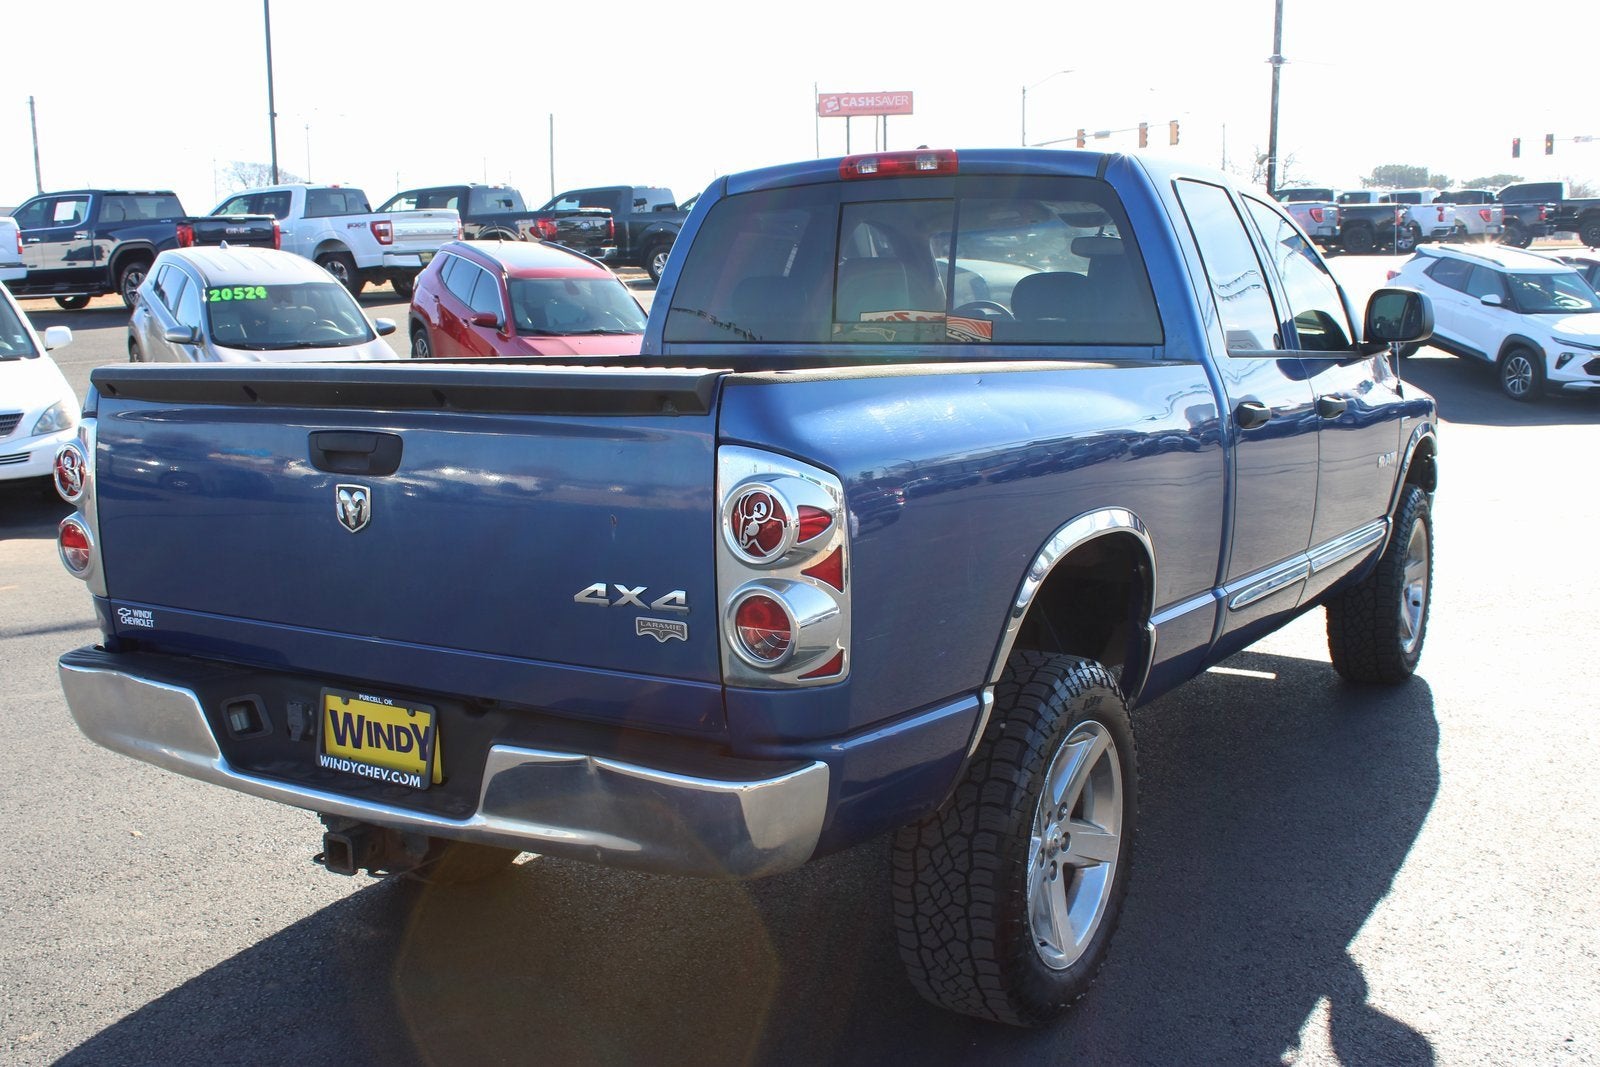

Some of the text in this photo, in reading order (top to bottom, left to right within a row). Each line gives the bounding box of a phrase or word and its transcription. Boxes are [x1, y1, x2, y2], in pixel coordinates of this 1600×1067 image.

[208, 286, 268, 302] 20524
[132, 609, 152, 619] WINDY
[120, 615, 154, 628] CHEVROLET
[639, 620, 682, 631] LARAMIE
[358, 694, 393, 706] PURCELL, OK
[319, 755, 422, 788] WINDYCHEV.COM
